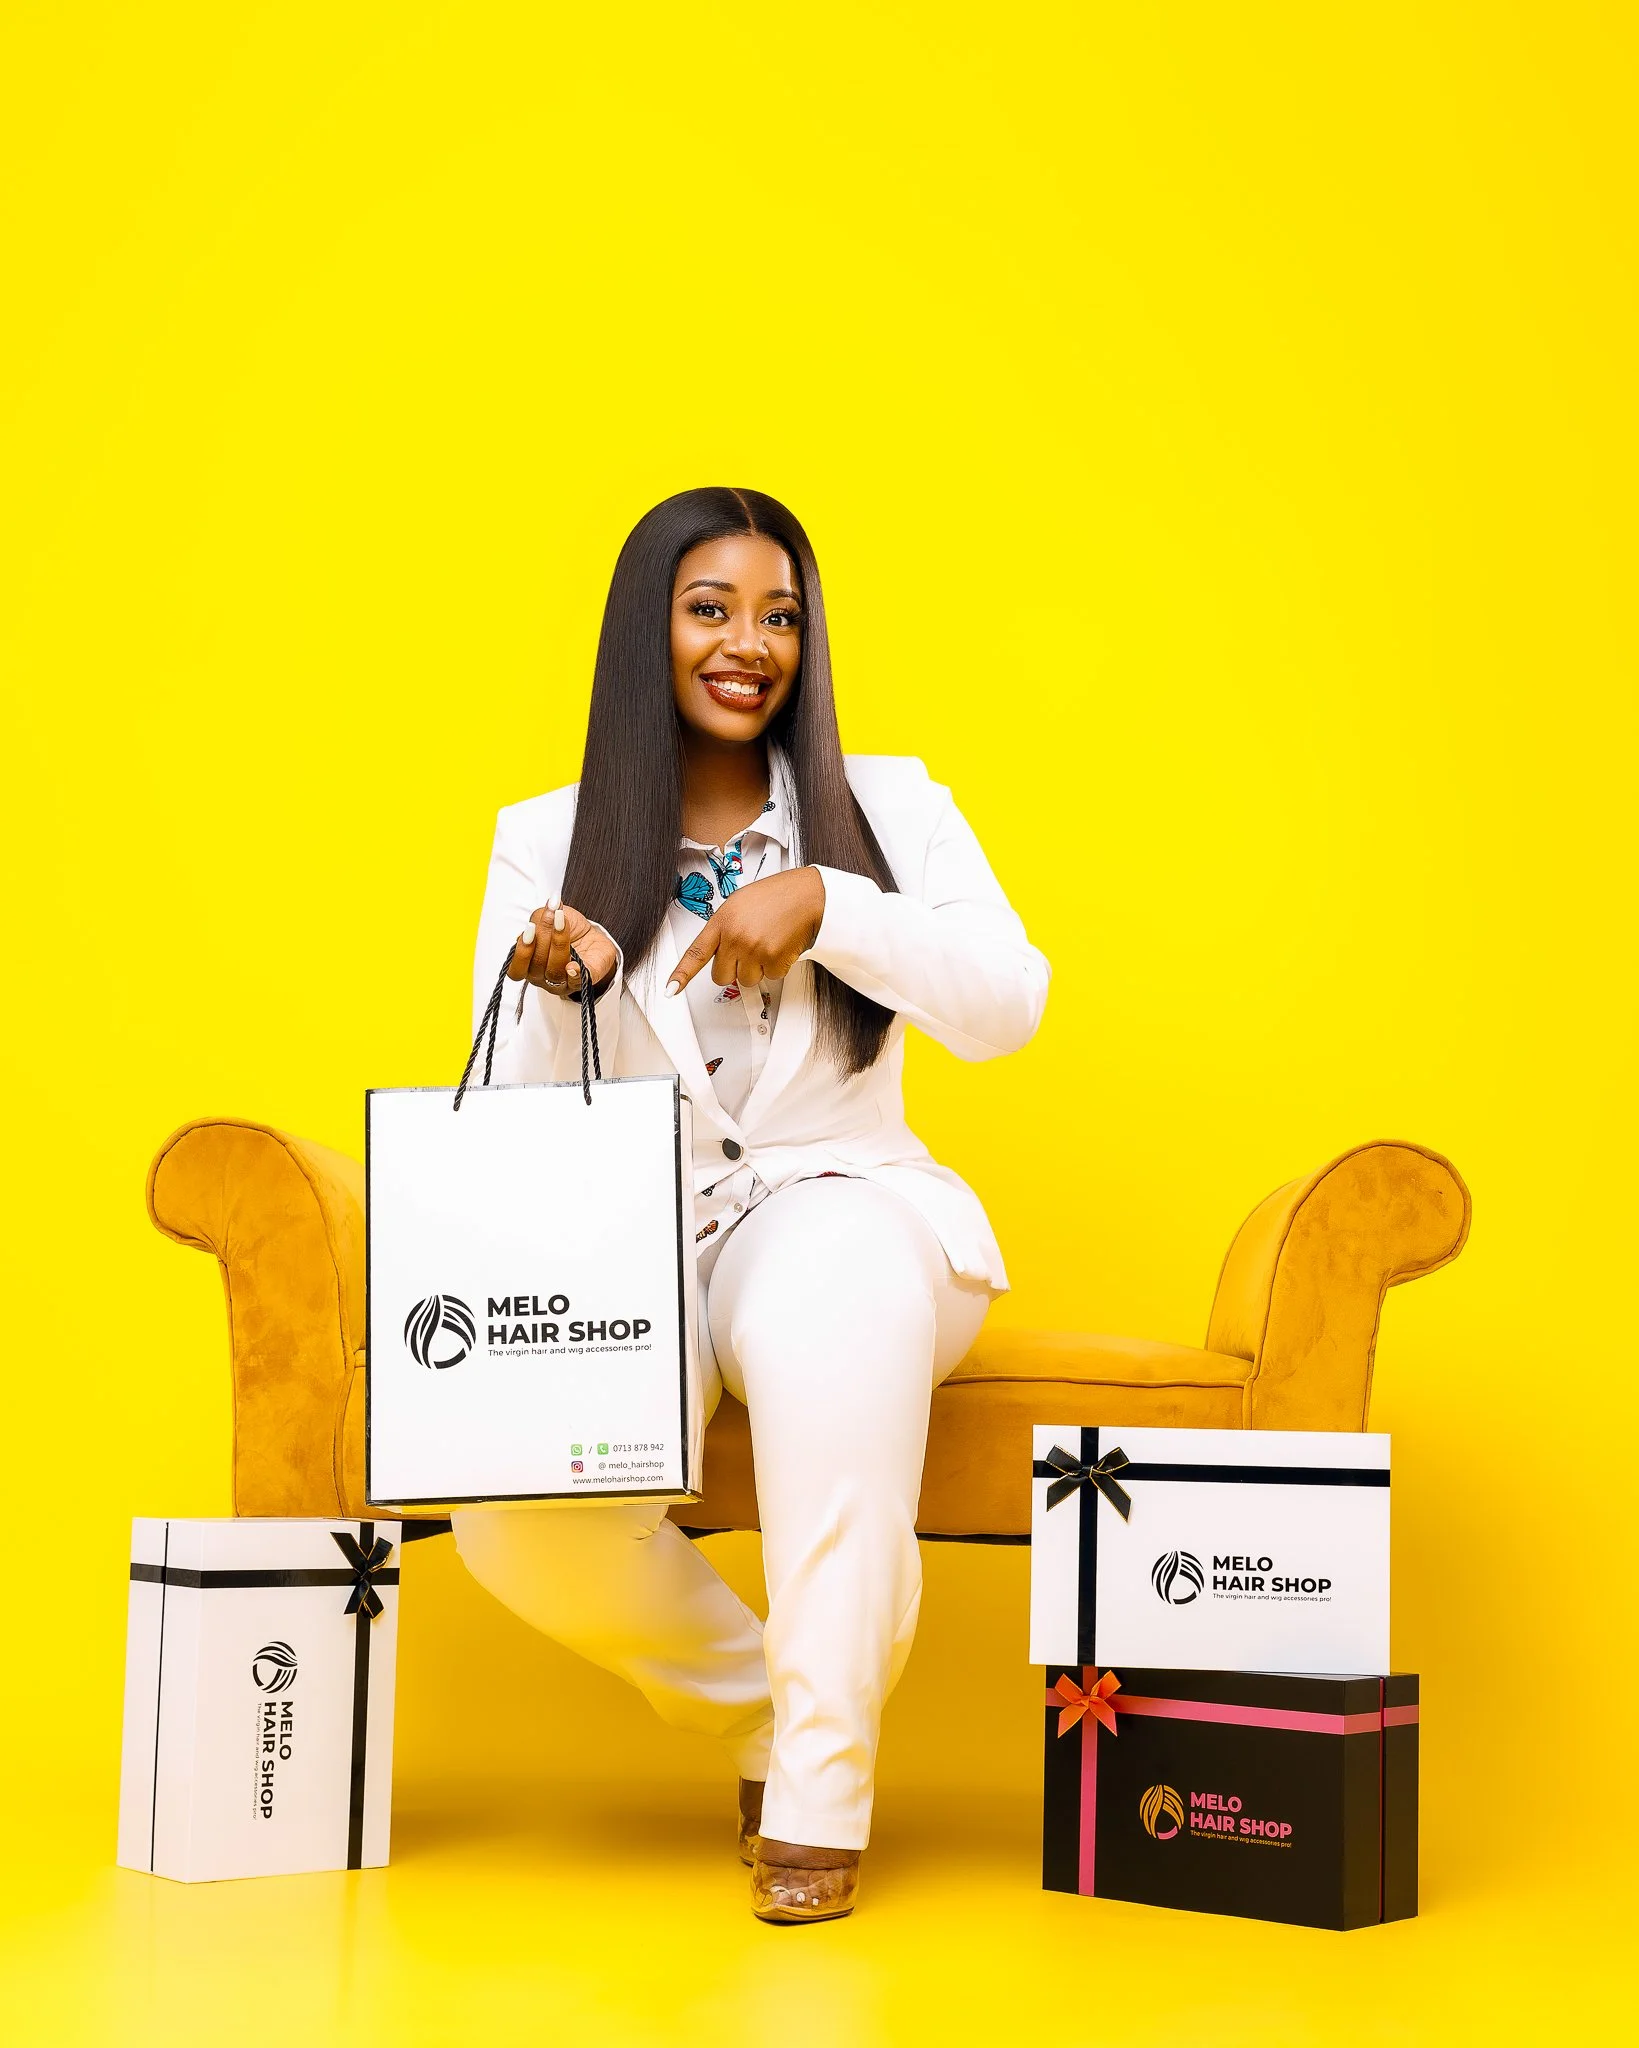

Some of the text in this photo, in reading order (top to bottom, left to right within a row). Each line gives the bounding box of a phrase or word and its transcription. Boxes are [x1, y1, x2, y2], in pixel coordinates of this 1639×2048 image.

[488, 1294, 570, 1317] MELO
[488, 1319, 652, 1345] HAIR SHOP
[488, 1344, 652, 1358] The virgin hair and wig accessories pro!
[609, 1460, 664, 1469] melo_hairshop
[573, 1475, 663, 1484] www.melohairshop.com
[1213, 1556, 1273, 1571] MELO
[1213, 1576, 1332, 1593] HAIR SHOP
[279, 1701, 293, 1760] MELO
[261, 1702, 276, 1819] HAIR SHOP
[1190, 1792, 1242, 1812] MELO
[1190, 1812, 1293, 1838] HAIR SHOP
[1201, 1831, 1216, 1839] virgin
[1239, 1836, 1249, 1844] wig
[1250, 1838, 1280, 1846] accessories
